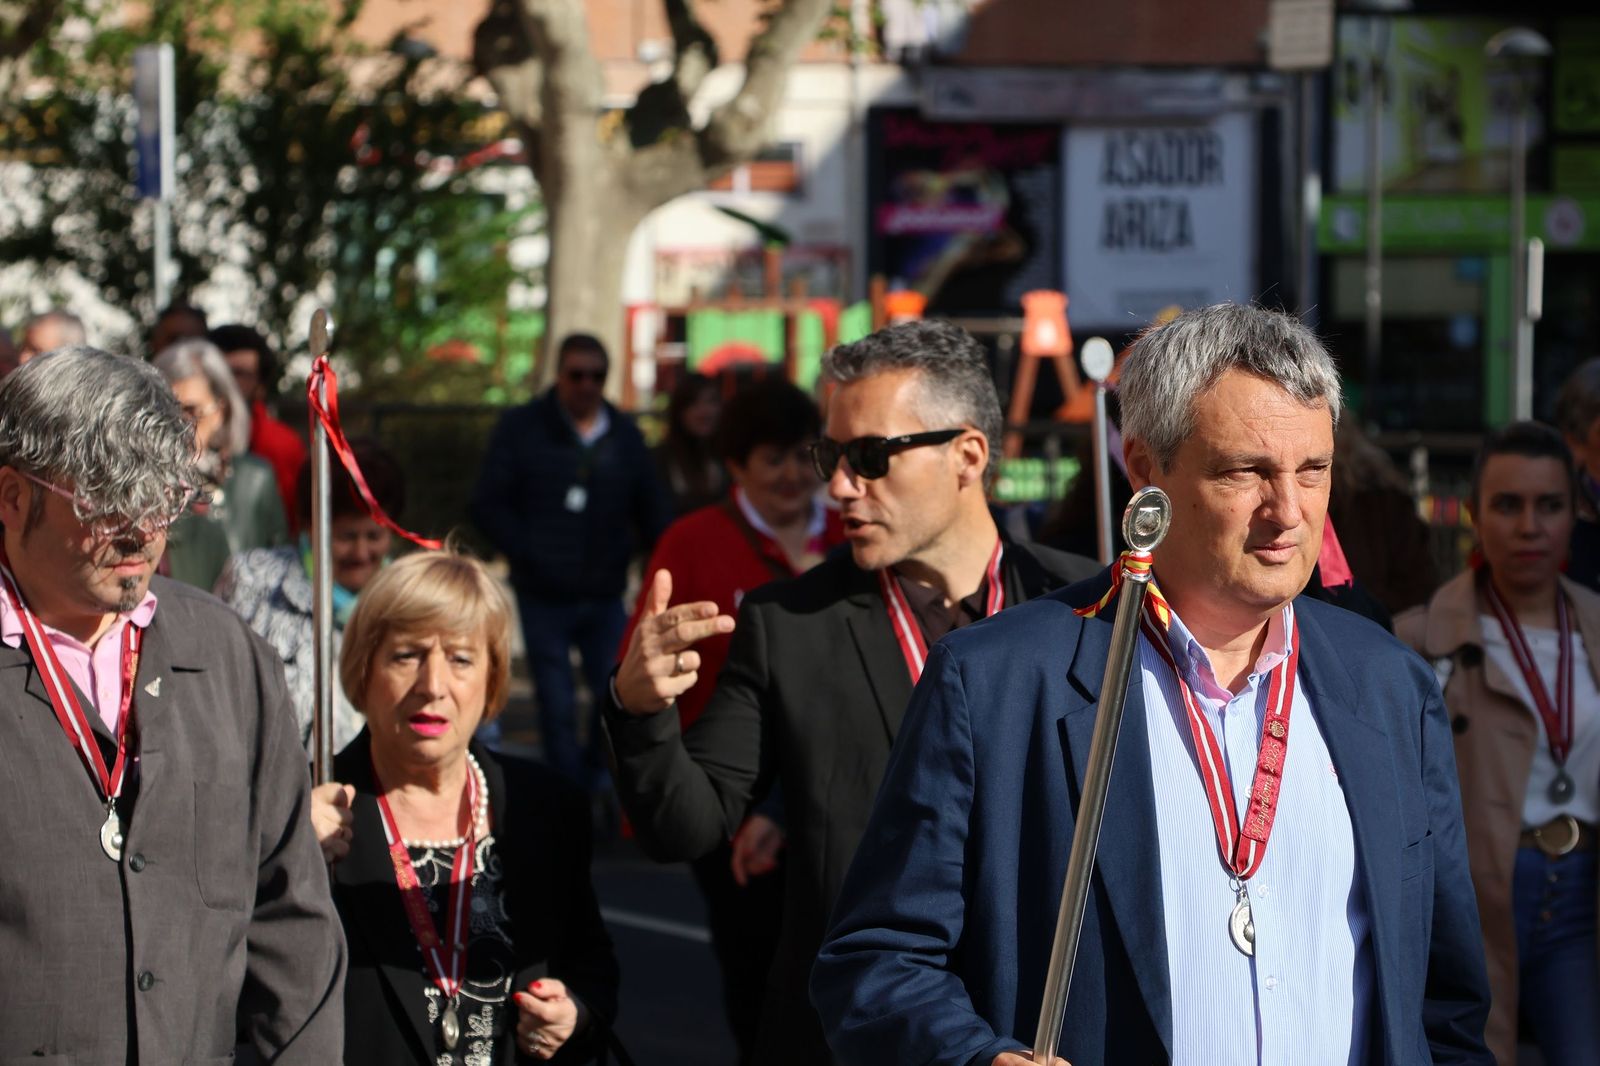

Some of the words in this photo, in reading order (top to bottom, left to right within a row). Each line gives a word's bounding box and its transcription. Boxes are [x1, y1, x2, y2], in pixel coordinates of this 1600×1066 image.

[1100, 127, 1224, 188] ASADOR
[1100, 198, 1195, 249] ARIZA
[1251, 776, 1274, 840] Mayordomo
